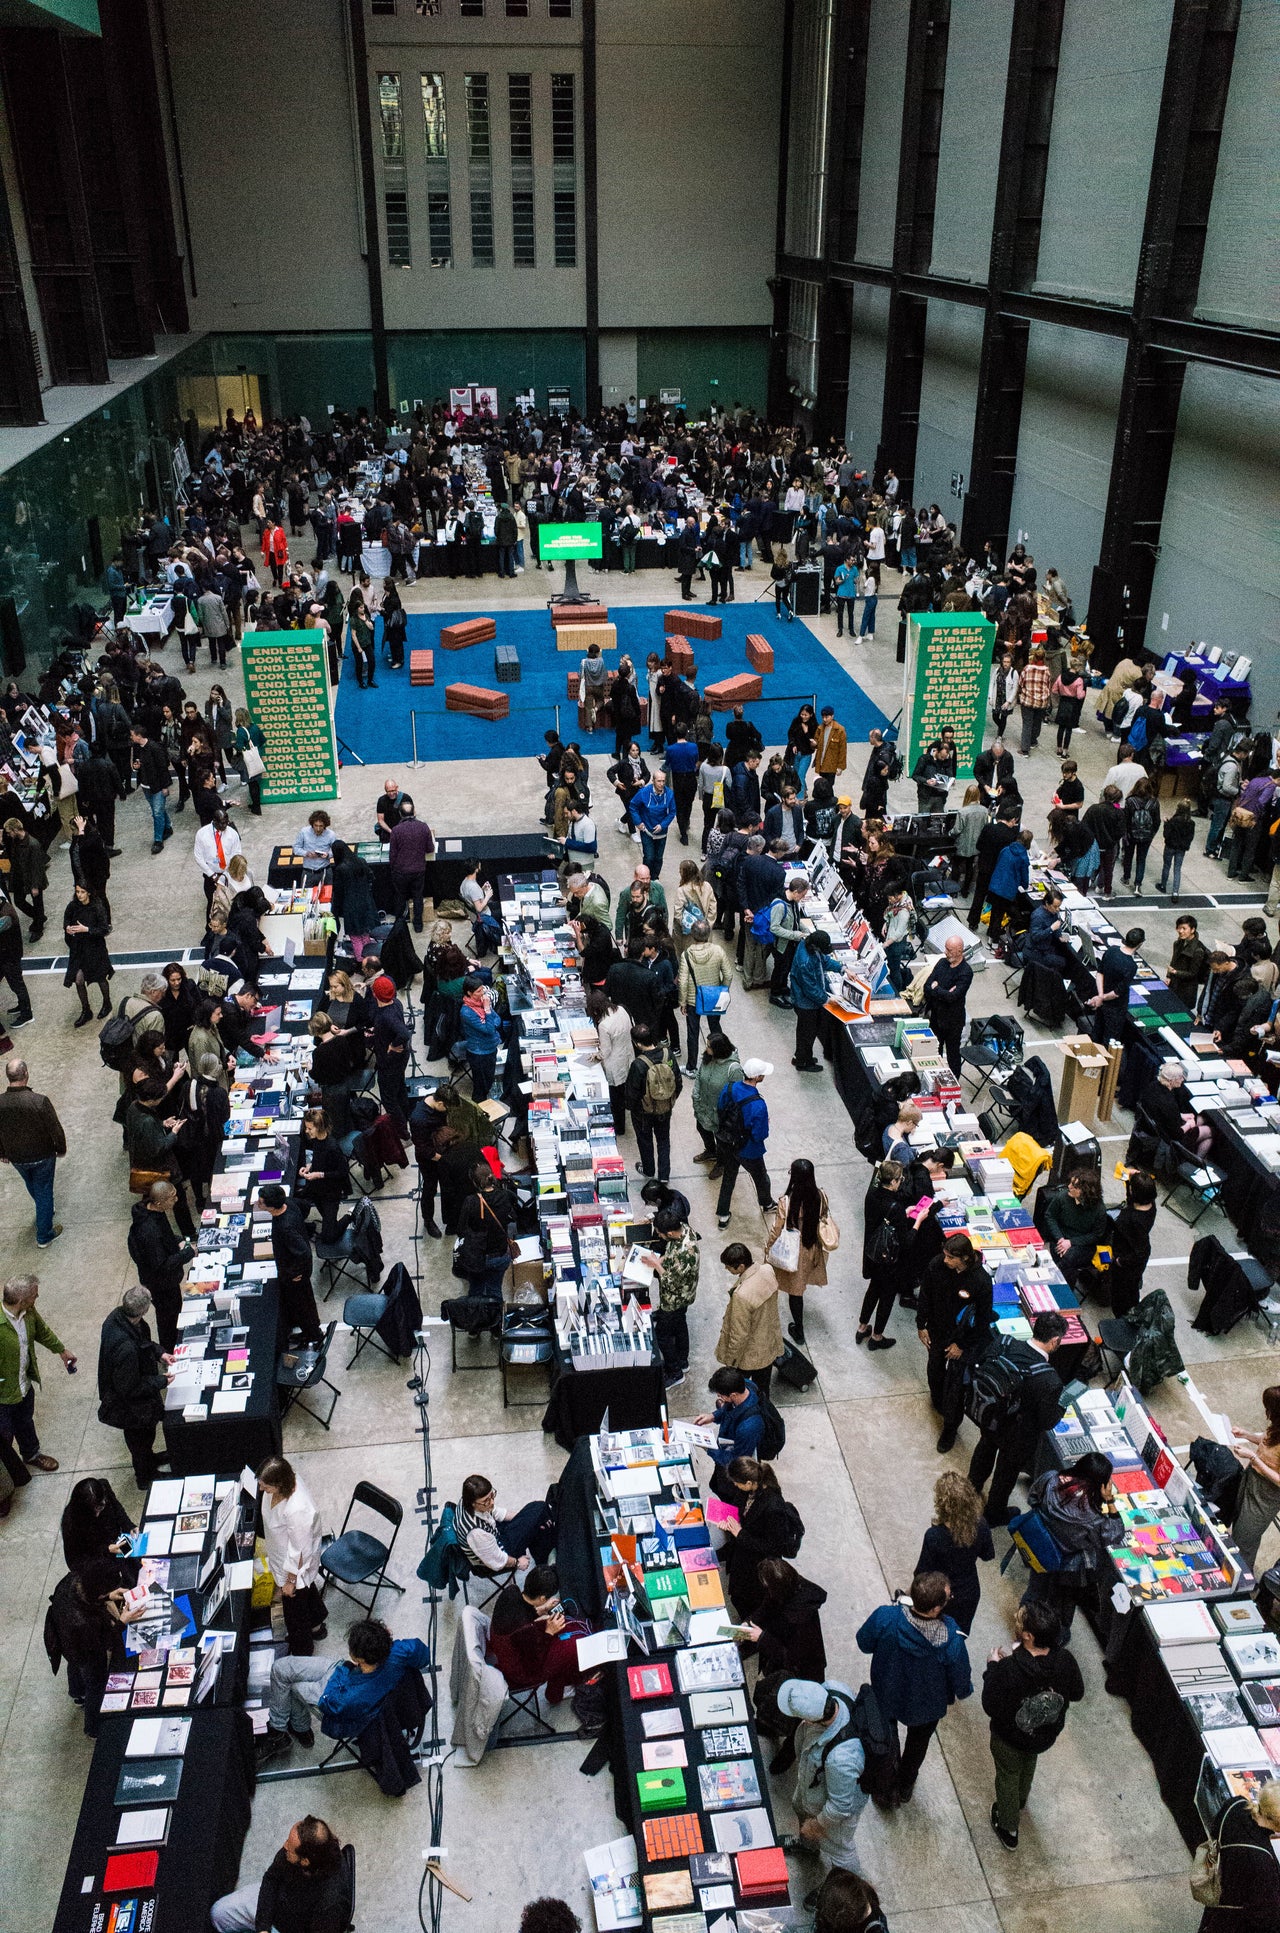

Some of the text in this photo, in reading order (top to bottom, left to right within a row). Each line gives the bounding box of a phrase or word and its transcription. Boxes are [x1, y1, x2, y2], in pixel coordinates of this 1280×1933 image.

[253, 647, 312, 655] ENDLESS
[247, 655, 320, 665] BOOK CLUB
[931, 653, 946, 661] BY
[255, 664, 314, 672] ENDLESS
[257, 680, 315, 688] ENDLESS
[929, 677, 944, 685] BY
[251, 688, 323, 698] BOOK CLUB
[258, 697, 317, 705] ENDLESS
[261, 713, 319, 721] ENDLESS
[293, 721, 326, 729] CLUB
[923, 731, 975, 739] PUISH,
[295, 737, 328, 745] CLUB
[298, 769, 331, 777] CLUB
[269, 778, 325, 786] ENDLESS
[263, 787, 297, 796] BOOK
[139, 1901, 149, 1932] AMERICA
[144, 1899, 155, 1932] GOODBYE
[95, 1913, 105, 1932] BRAD
